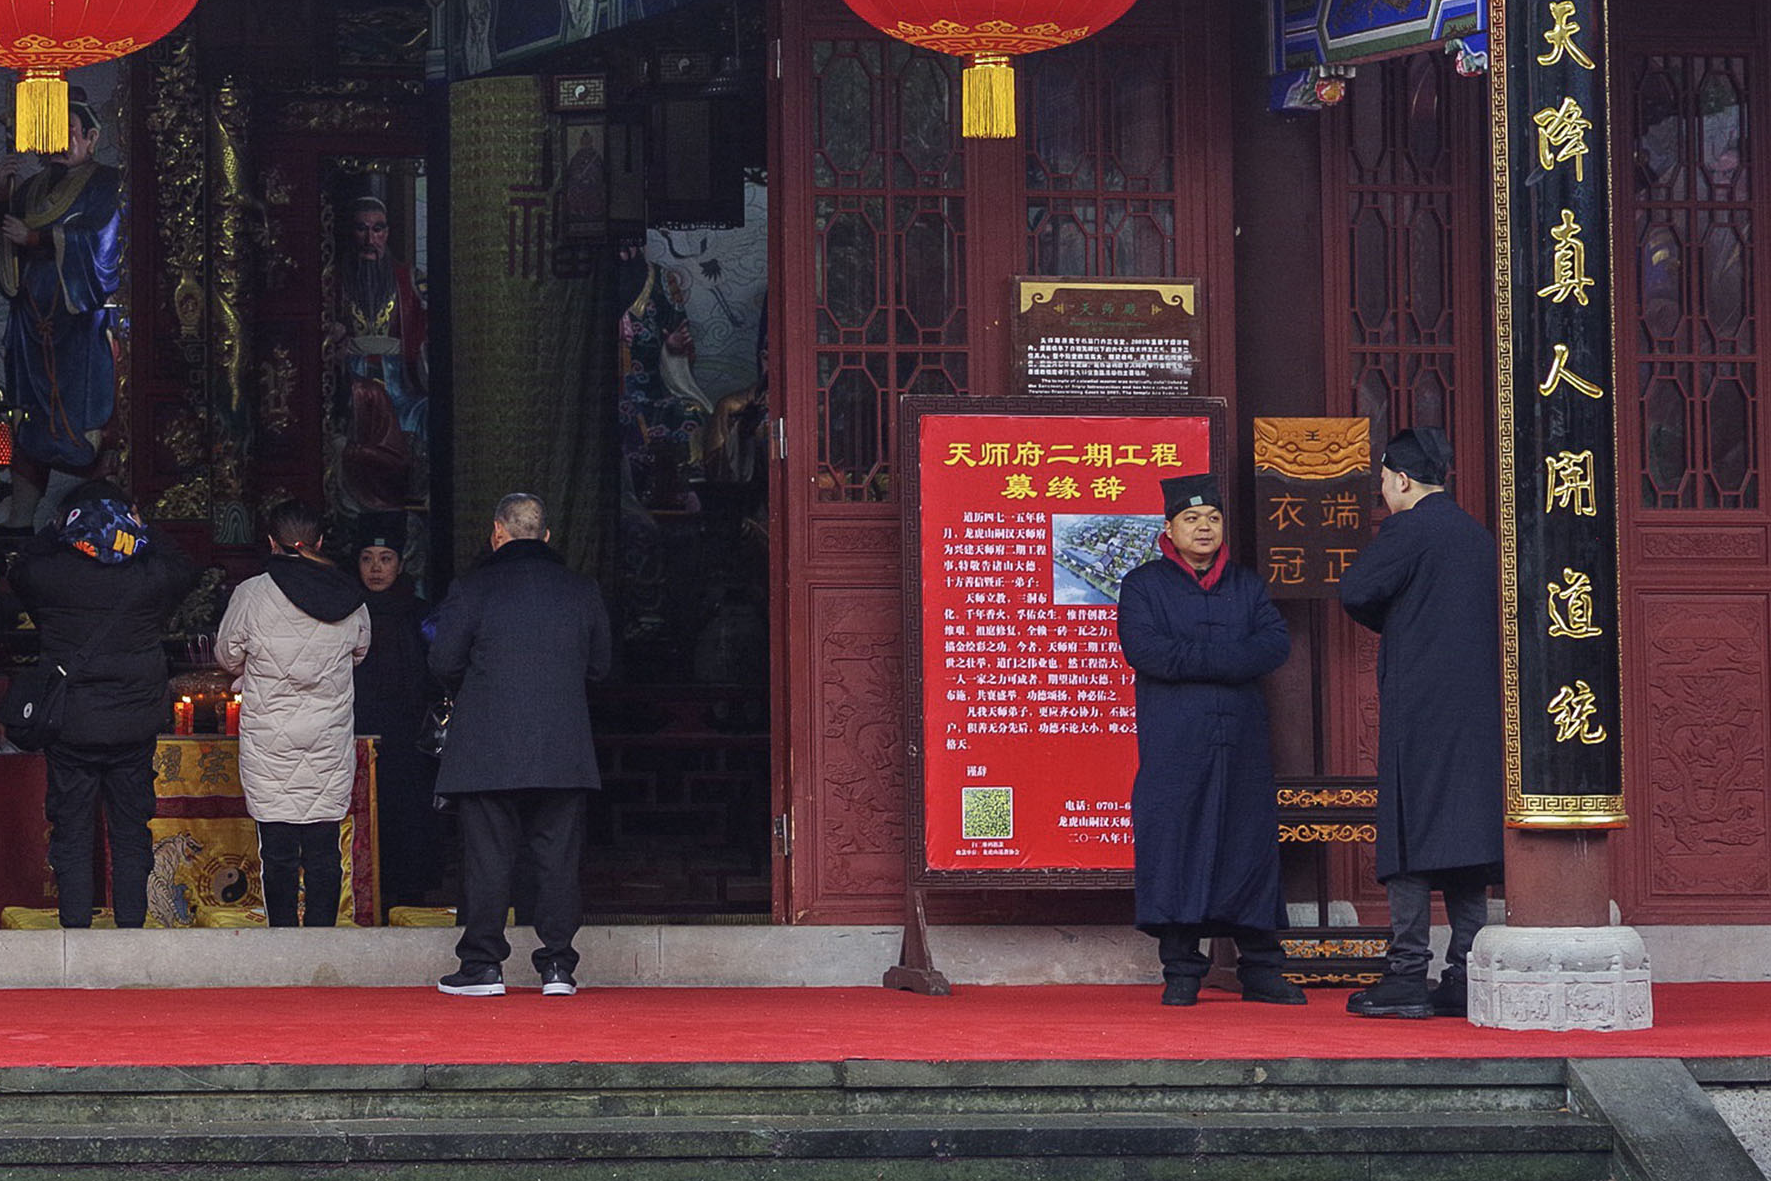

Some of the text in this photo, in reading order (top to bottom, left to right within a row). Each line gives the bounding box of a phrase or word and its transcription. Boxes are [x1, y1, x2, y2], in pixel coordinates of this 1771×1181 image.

[943, 442, 1183, 468] 天师府二期工程
[1000, 474, 1127, 501] 募缘辞
[943, 544, 1047, 556] 为兴建天师府二期工程
[944, 641, 1123, 653] 描金绘彩之功。今者，天师府二期工程
[945, 657, 1134, 669] 世之壮举，道门之伟业也。然工程浩大，
[1058, 816, 1134, 828] 龙虎山嗣汉天师
